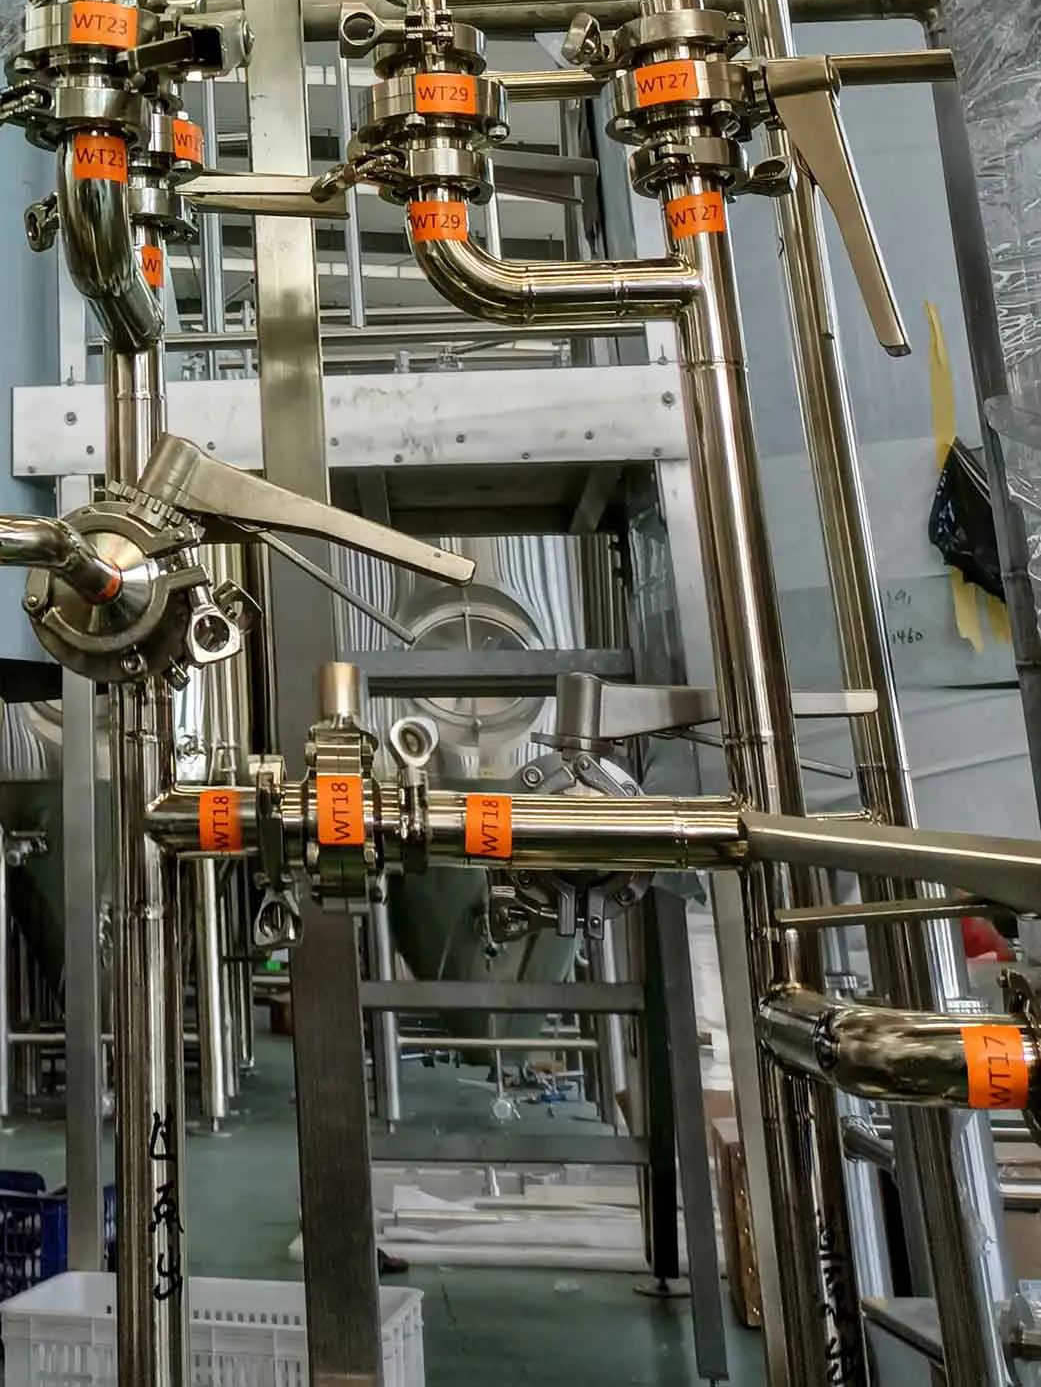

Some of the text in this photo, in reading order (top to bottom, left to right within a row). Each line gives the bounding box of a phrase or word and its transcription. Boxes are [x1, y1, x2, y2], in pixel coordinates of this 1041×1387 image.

[73, 13, 128, 35] WT23
[418, 86, 469, 102] WT29
[637, 72, 688, 94] WT27
[413, 213, 462, 228] WT29
[669, 204, 718, 227] WT27
[212, 795, 230, 849] WT18
[331, 781, 351, 842] WT18
[480, 799, 500, 853] WT18
[983, 1035, 1012, 1107] WT17
